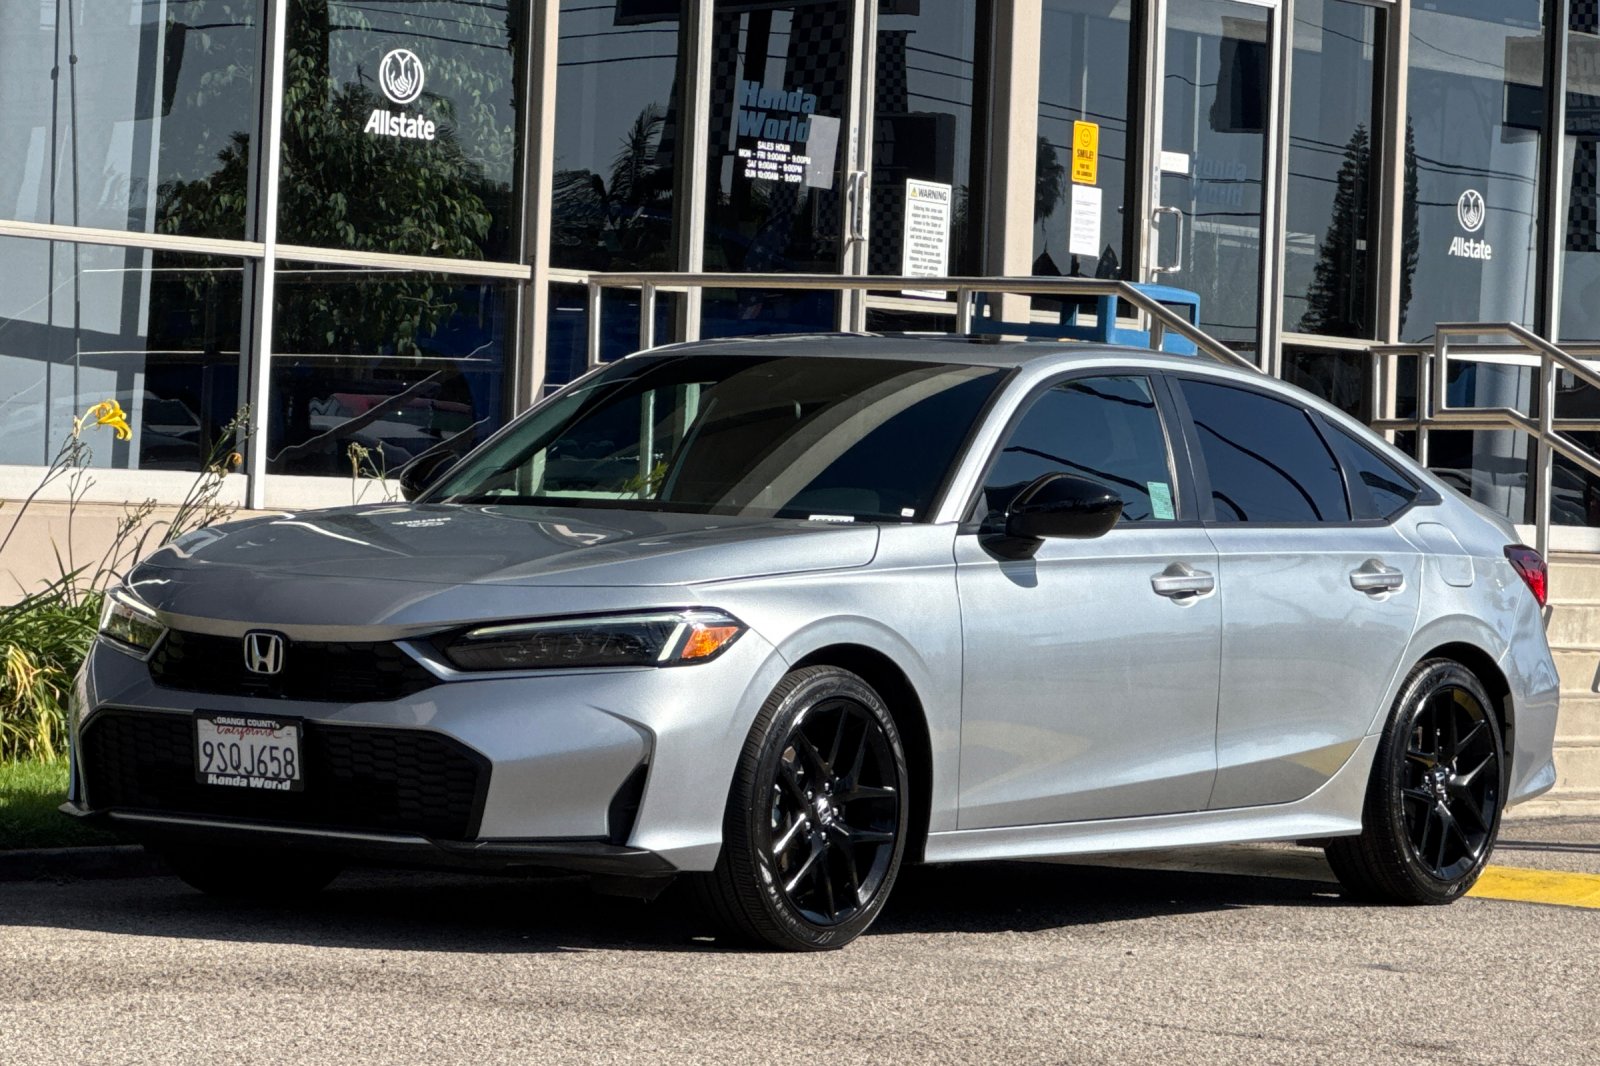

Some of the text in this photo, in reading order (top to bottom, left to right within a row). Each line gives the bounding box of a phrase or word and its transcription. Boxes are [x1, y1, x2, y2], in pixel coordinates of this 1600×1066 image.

[740, 80, 817, 114] Honda
[364, 109, 435, 140] Allstate
[738, 109, 813, 143] World
[757, 140, 774, 151] SALES
[738, 148, 752, 158] MON
[757, 150, 766, 160] FRI
[918, 188, 947, 201] WARNING
[1448, 236, 1492, 260] Allstate
[217, 716, 276, 729] ORANGE COUNTY
[216, 725, 281, 741] California
[202, 741, 296, 779] 9SQJ658
[207, 773, 248, 787] Honda
